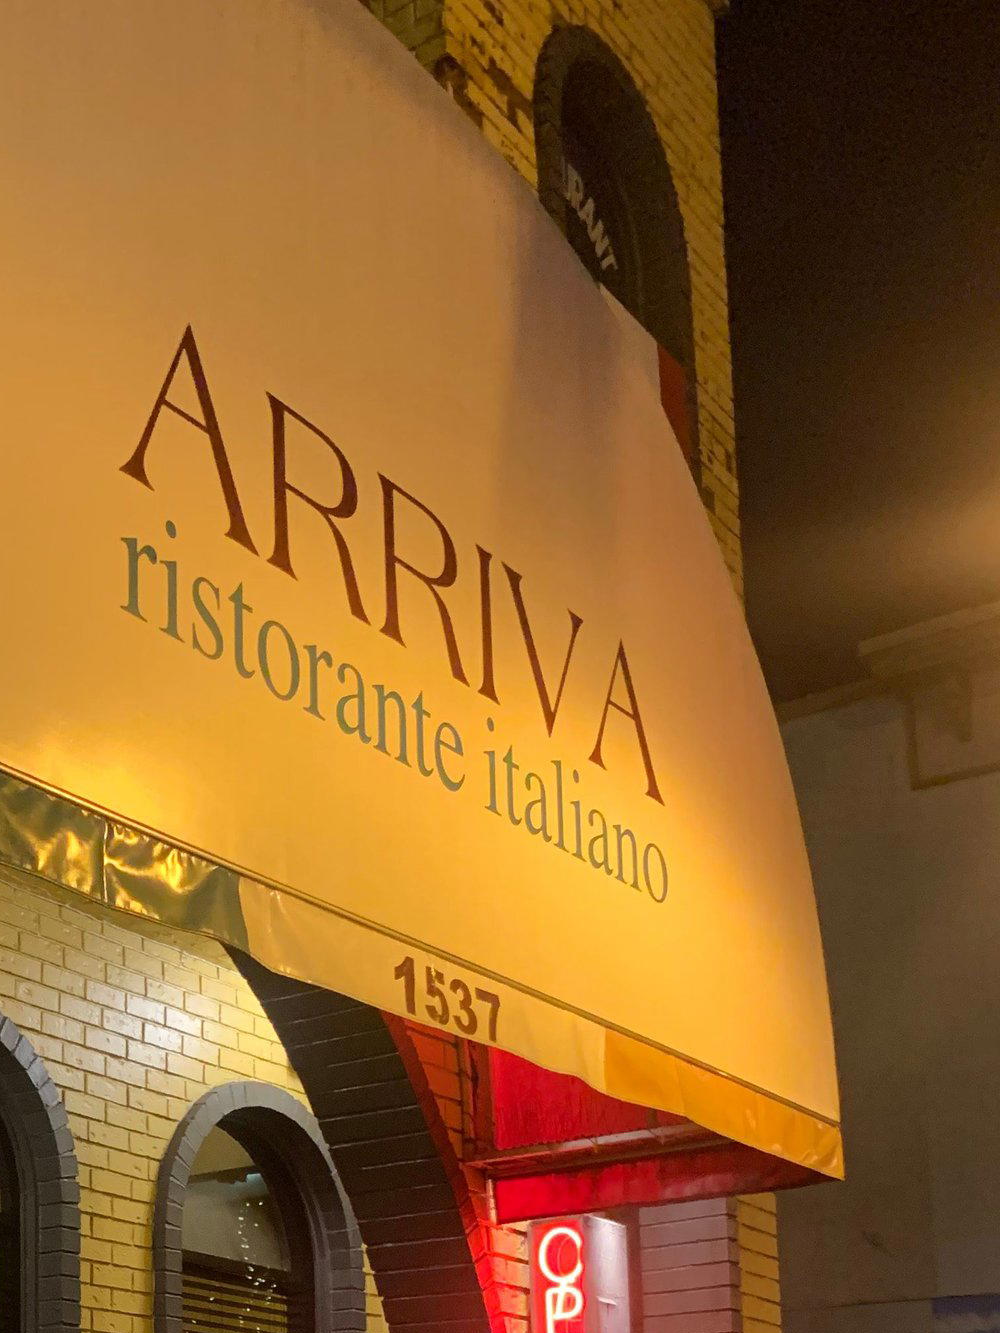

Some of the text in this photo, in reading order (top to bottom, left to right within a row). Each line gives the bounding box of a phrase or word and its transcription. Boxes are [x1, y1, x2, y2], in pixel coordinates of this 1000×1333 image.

[118, 323, 666, 807] ARRIVA
[119, 519, 669, 904] ristorante italiano
[394, 956, 501, 1043] 1537
